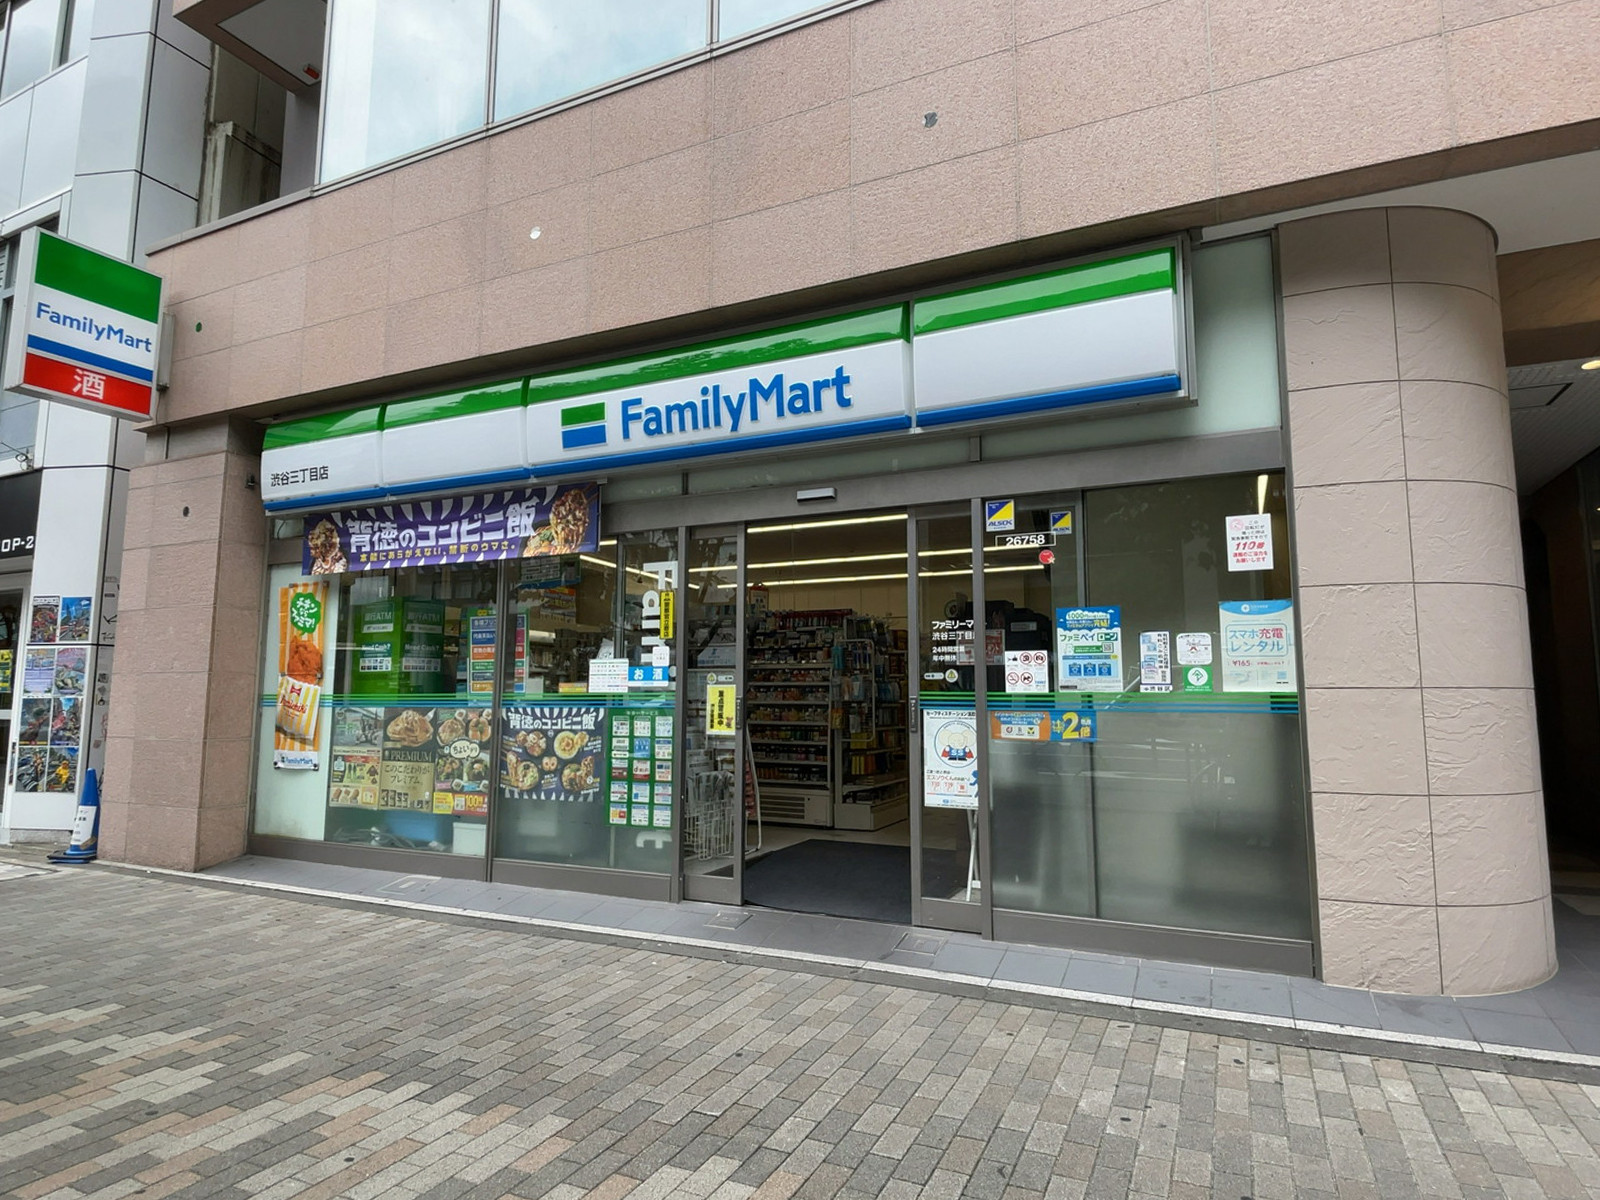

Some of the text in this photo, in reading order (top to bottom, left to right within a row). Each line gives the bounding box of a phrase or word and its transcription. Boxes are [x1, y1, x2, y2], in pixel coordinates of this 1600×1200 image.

[36, 302, 153, 353] FamilyMart
[72, 369, 105, 400] 酒
[621, 365, 853, 440] FamilyMart
[271, 466, 329, 487] 渋谷三丁目店
[348, 499, 537, 553] 背徳のコンビニ飯
[1005, 534, 1045, 547] 26758
[1236, 541, 1265, 551] 110番
[931, 619, 975, 630] ファミリーマ
[1229, 628, 1284, 639] スマホ充電
[1231, 640, 1284, 652] レンタル
[634, 668, 663, 681] お酒
[508, 712, 598, 731] 背徳のコンビニ飯
[391, 750, 431, 762] PREMIUM
